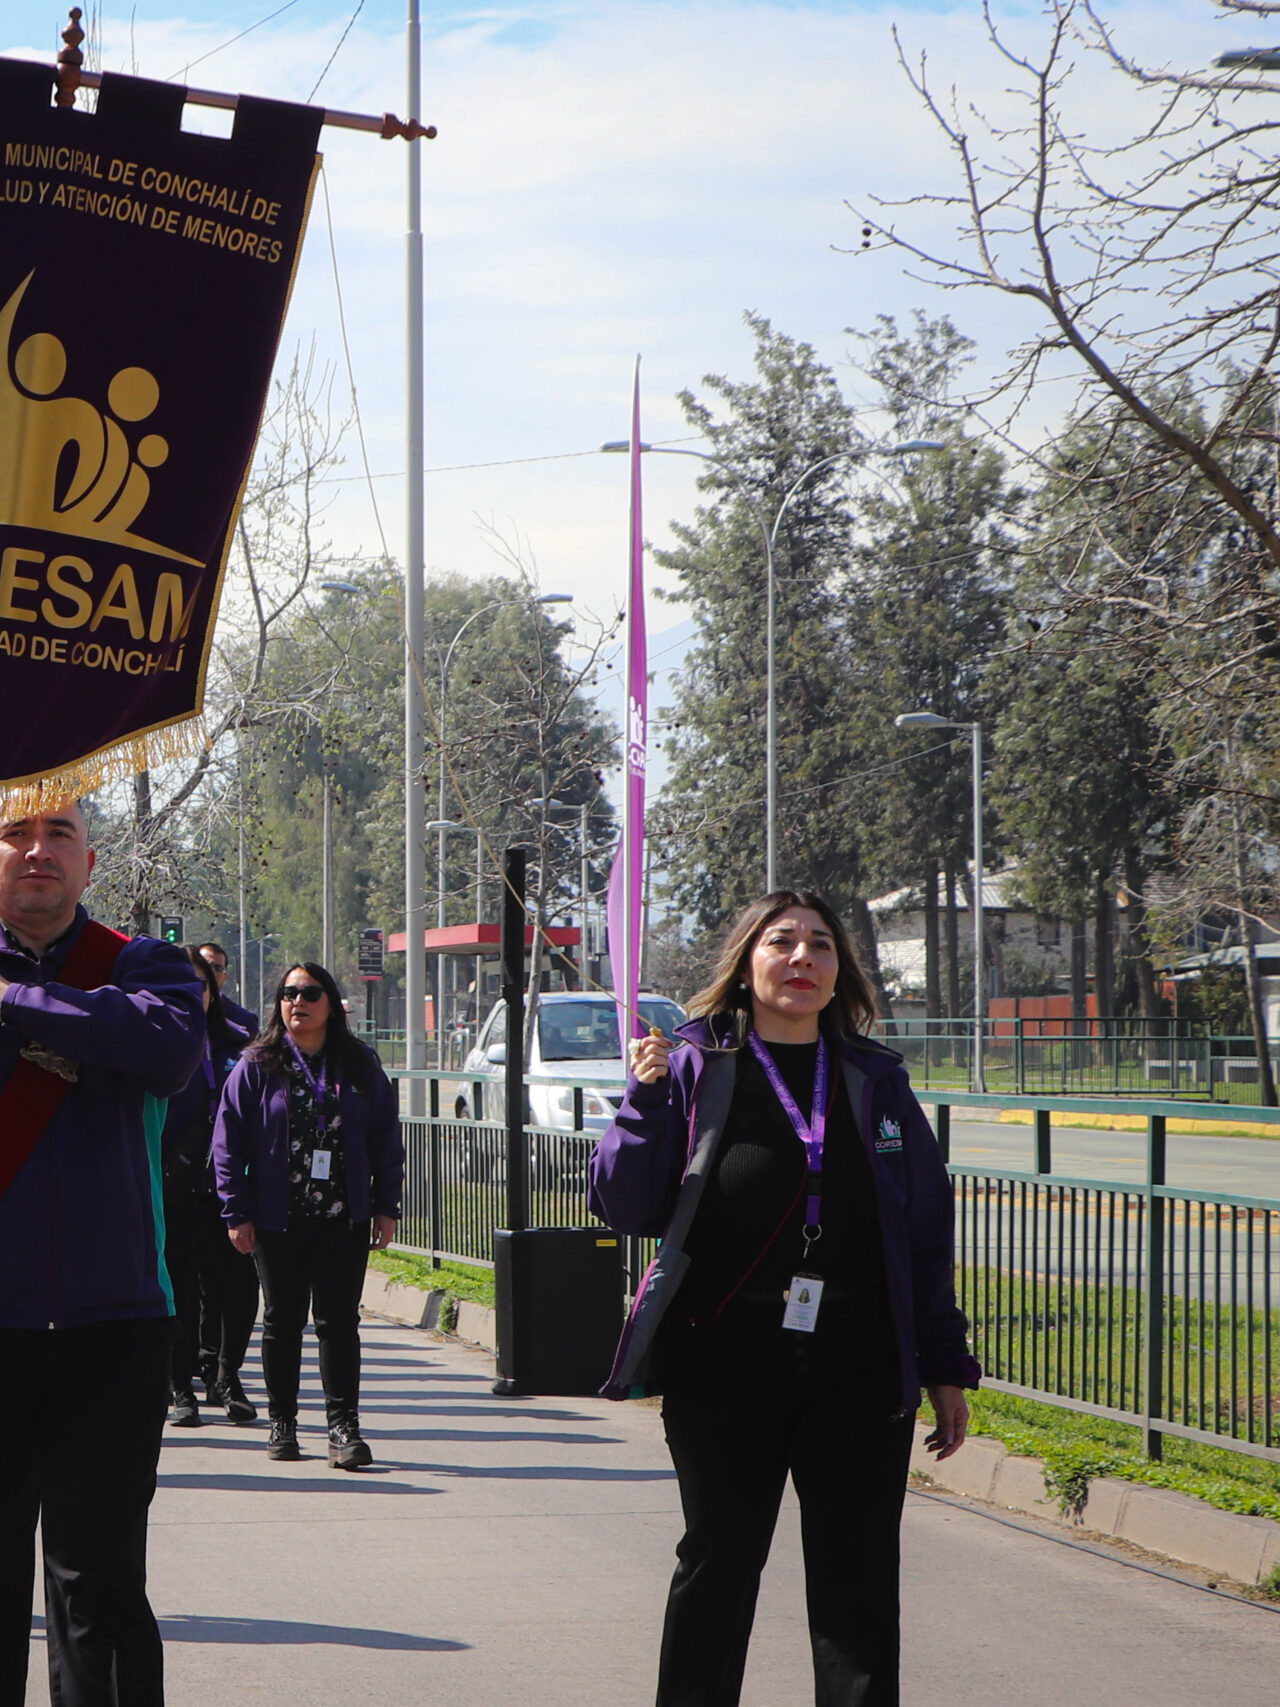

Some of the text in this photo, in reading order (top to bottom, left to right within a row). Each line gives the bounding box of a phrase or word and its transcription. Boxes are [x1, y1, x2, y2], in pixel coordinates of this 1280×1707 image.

[5, 143, 103, 179] MUNICIPAL
[108, 160, 137, 185] DE
[141, 166, 252, 218] CONCHALÍ
[252, 197, 282, 226] DE
[38, 181, 52, 205] Y
[52, 182, 146, 223] ATENCIÓN
[151, 206, 178, 234] DE
[183, 215, 283, 264] MENORES
[30, 636, 68, 663] DE
